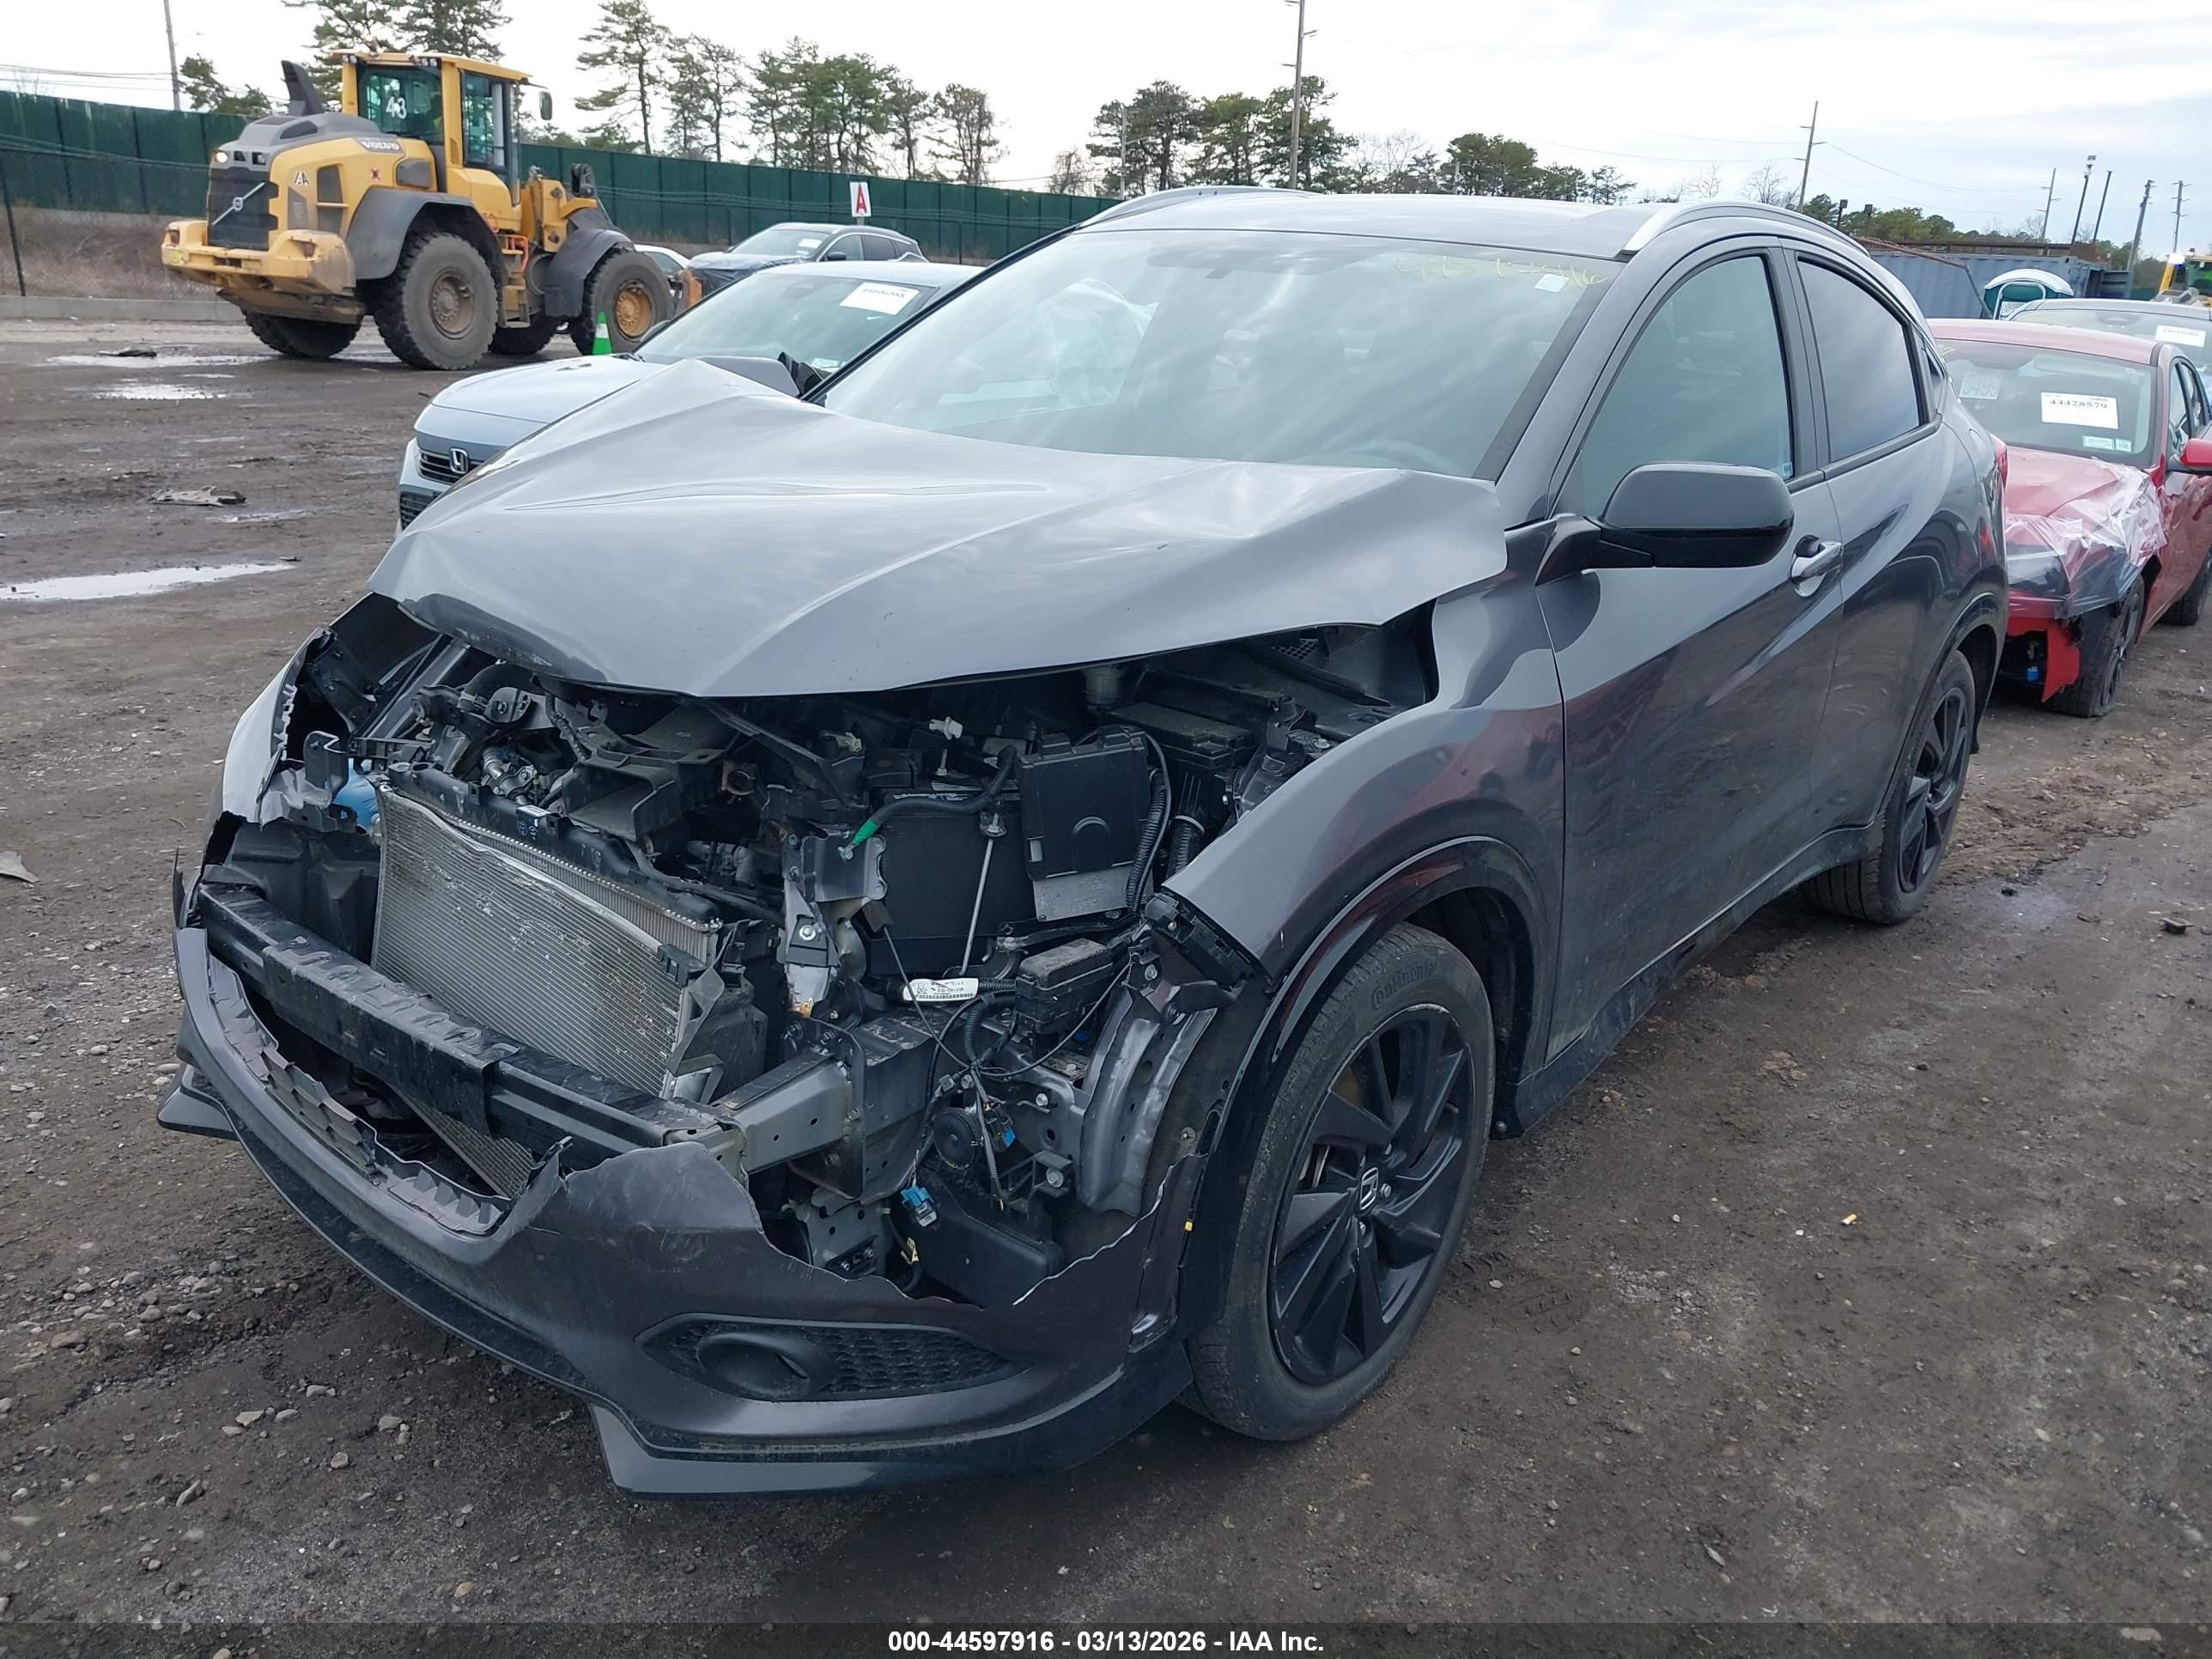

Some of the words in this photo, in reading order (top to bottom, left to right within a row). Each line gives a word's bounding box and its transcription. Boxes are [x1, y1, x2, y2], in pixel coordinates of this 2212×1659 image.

[386, 96, 407, 119] 43
[361, 141, 399, 150] VOLVO
[856, 184, 867, 214] A
